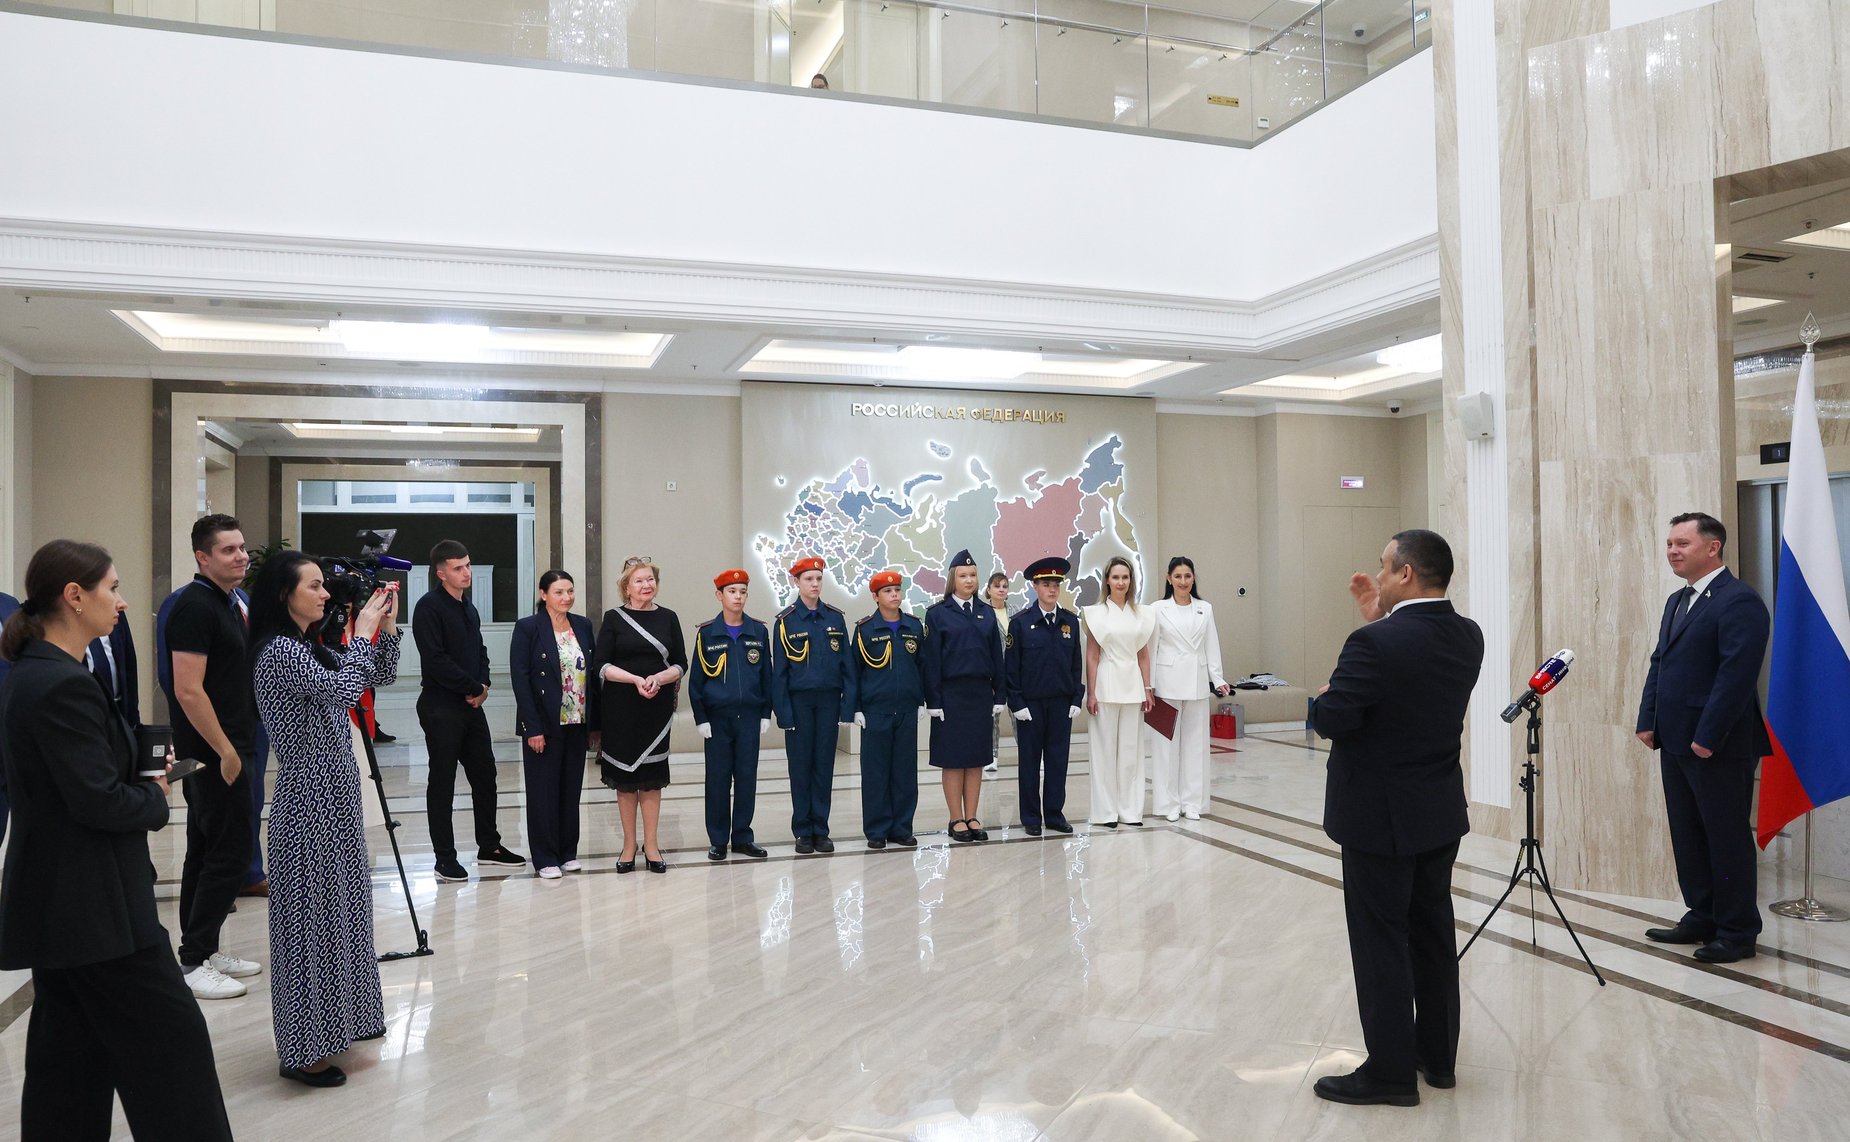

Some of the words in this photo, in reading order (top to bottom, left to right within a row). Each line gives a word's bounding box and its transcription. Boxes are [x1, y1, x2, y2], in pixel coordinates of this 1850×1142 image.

[851, 402, 966, 420] РОССИЙСКАЯ
[970, 408, 1066, 424] ФЕДЕРАЦИЯ
[1542, 676, 1557, 690] СЕНАТ
